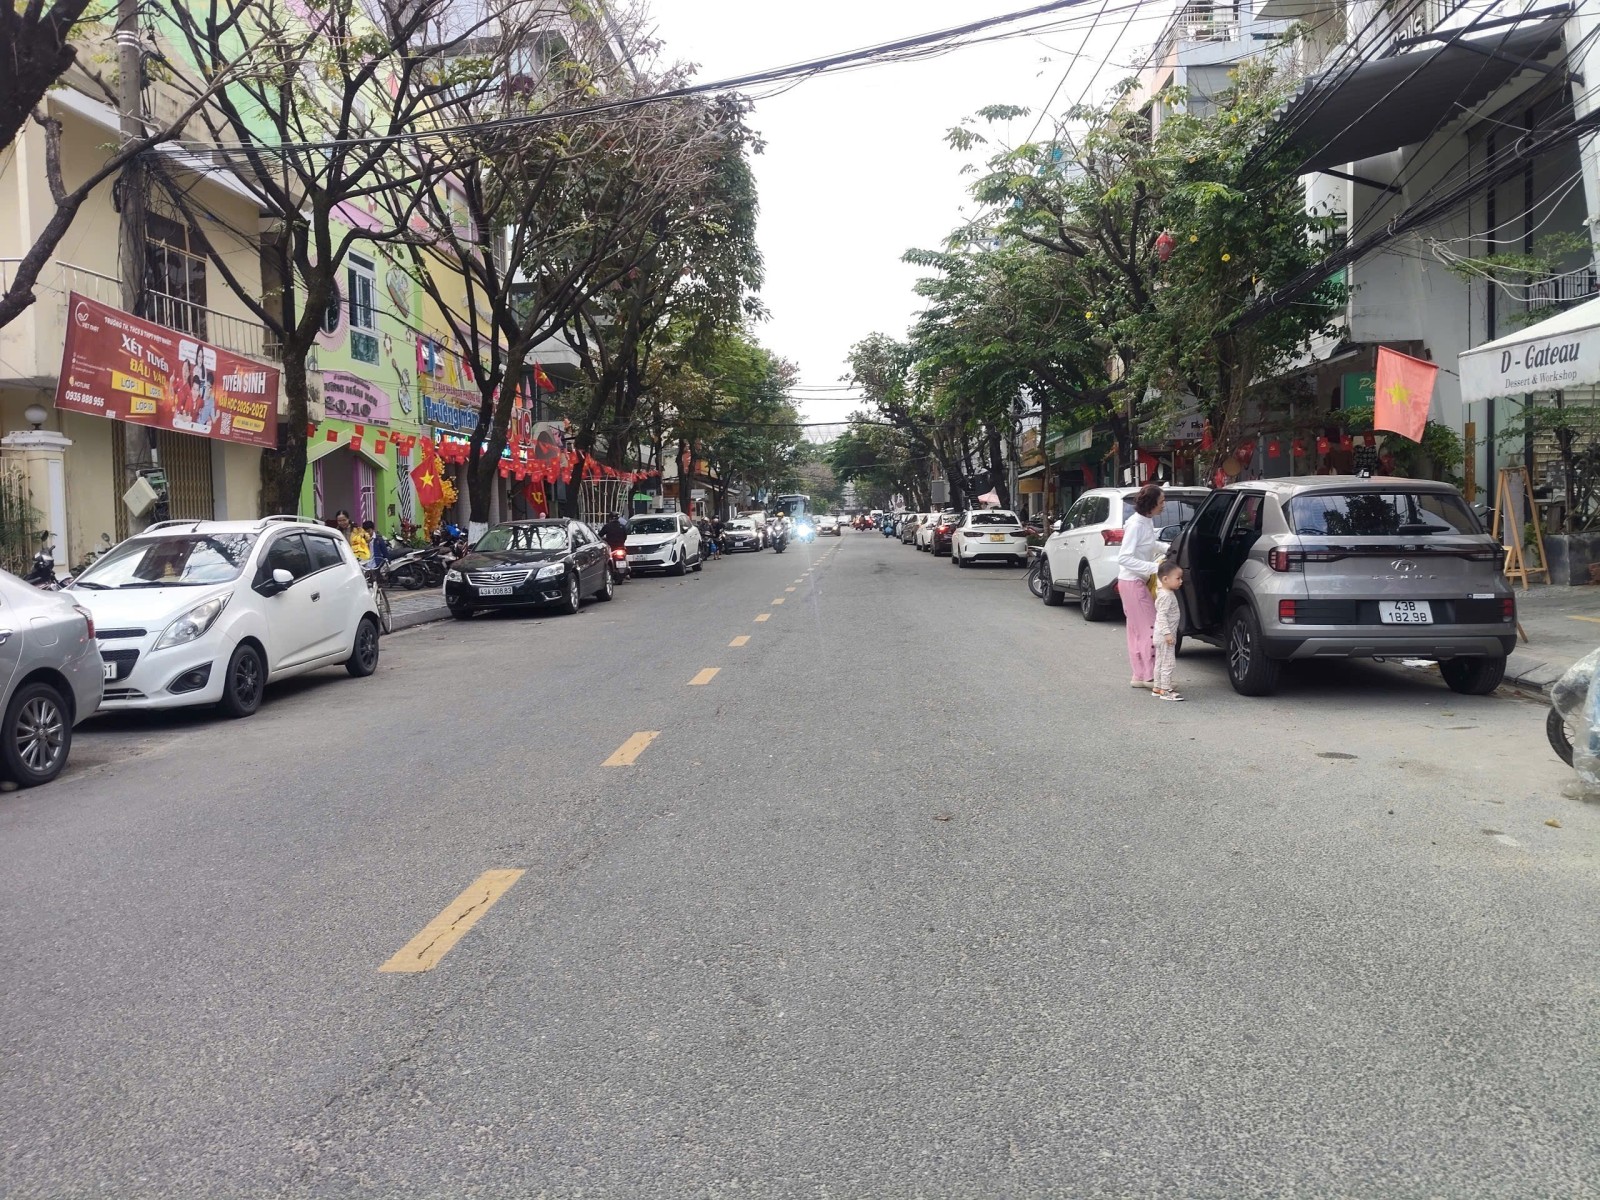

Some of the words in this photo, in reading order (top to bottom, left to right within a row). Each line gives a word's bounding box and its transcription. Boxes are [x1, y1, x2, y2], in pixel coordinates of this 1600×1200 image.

[122, 333, 143, 357] XÉT
[1501, 350, 1512, 374] D
[1525, 342, 1581, 370] Gateau
[242, 371, 267, 395] SINH
[1505, 377, 1531, 389] Dessert
[1531, 375, 1538, 385] &
[1539, 369, 1578, 383] Workshop
[65, 390, 81, 402] 0935
[81, 394, 93, 405] 888
[92, 397, 105, 408] 955
[237, 399, 268, 419] 2026-2027
[1394, 601, 1416, 611] 43B
[1388, 612, 1428, 622] 182.98
